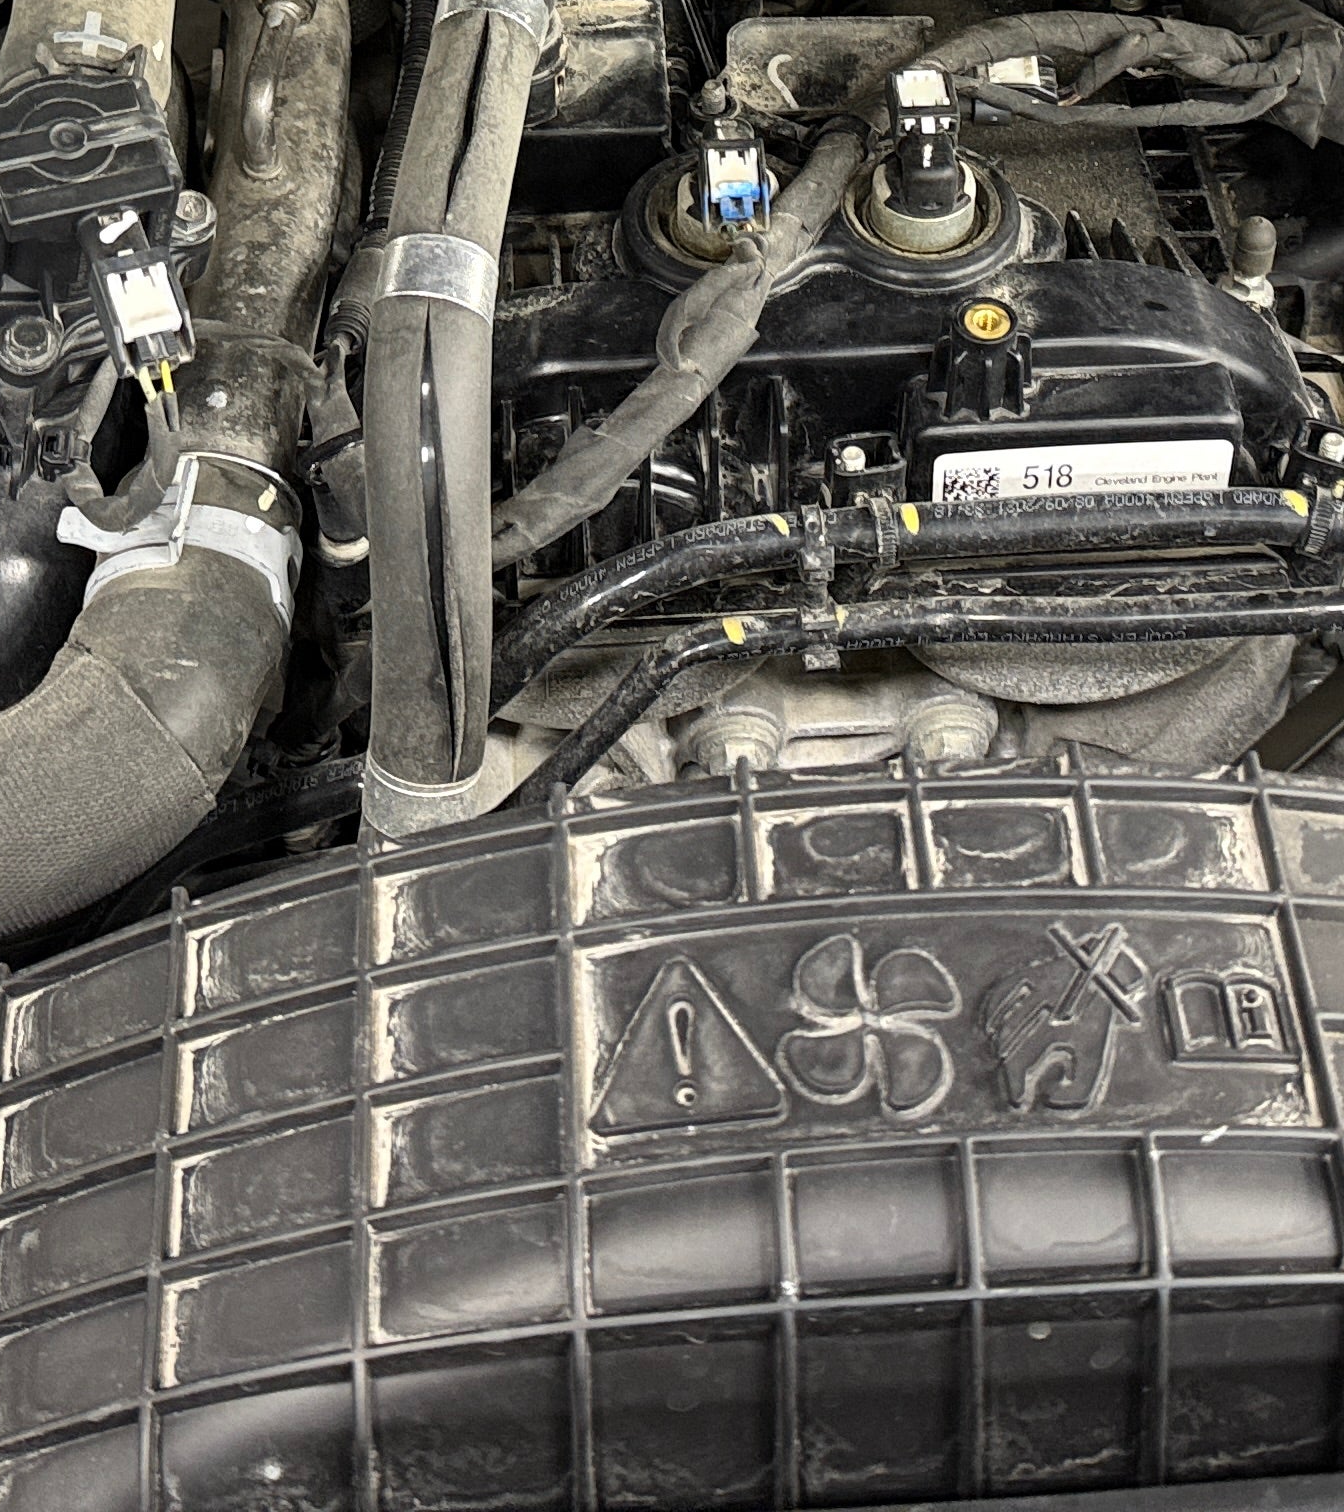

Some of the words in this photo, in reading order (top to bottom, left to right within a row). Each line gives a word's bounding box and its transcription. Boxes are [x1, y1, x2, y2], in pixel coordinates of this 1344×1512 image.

[1022, 463, 1073, 490] 518
[1095, 474, 1147, 486] Cleveland
[1151, 473, 1187, 484] Engine
[1191, 471, 1218, 482] Plant
